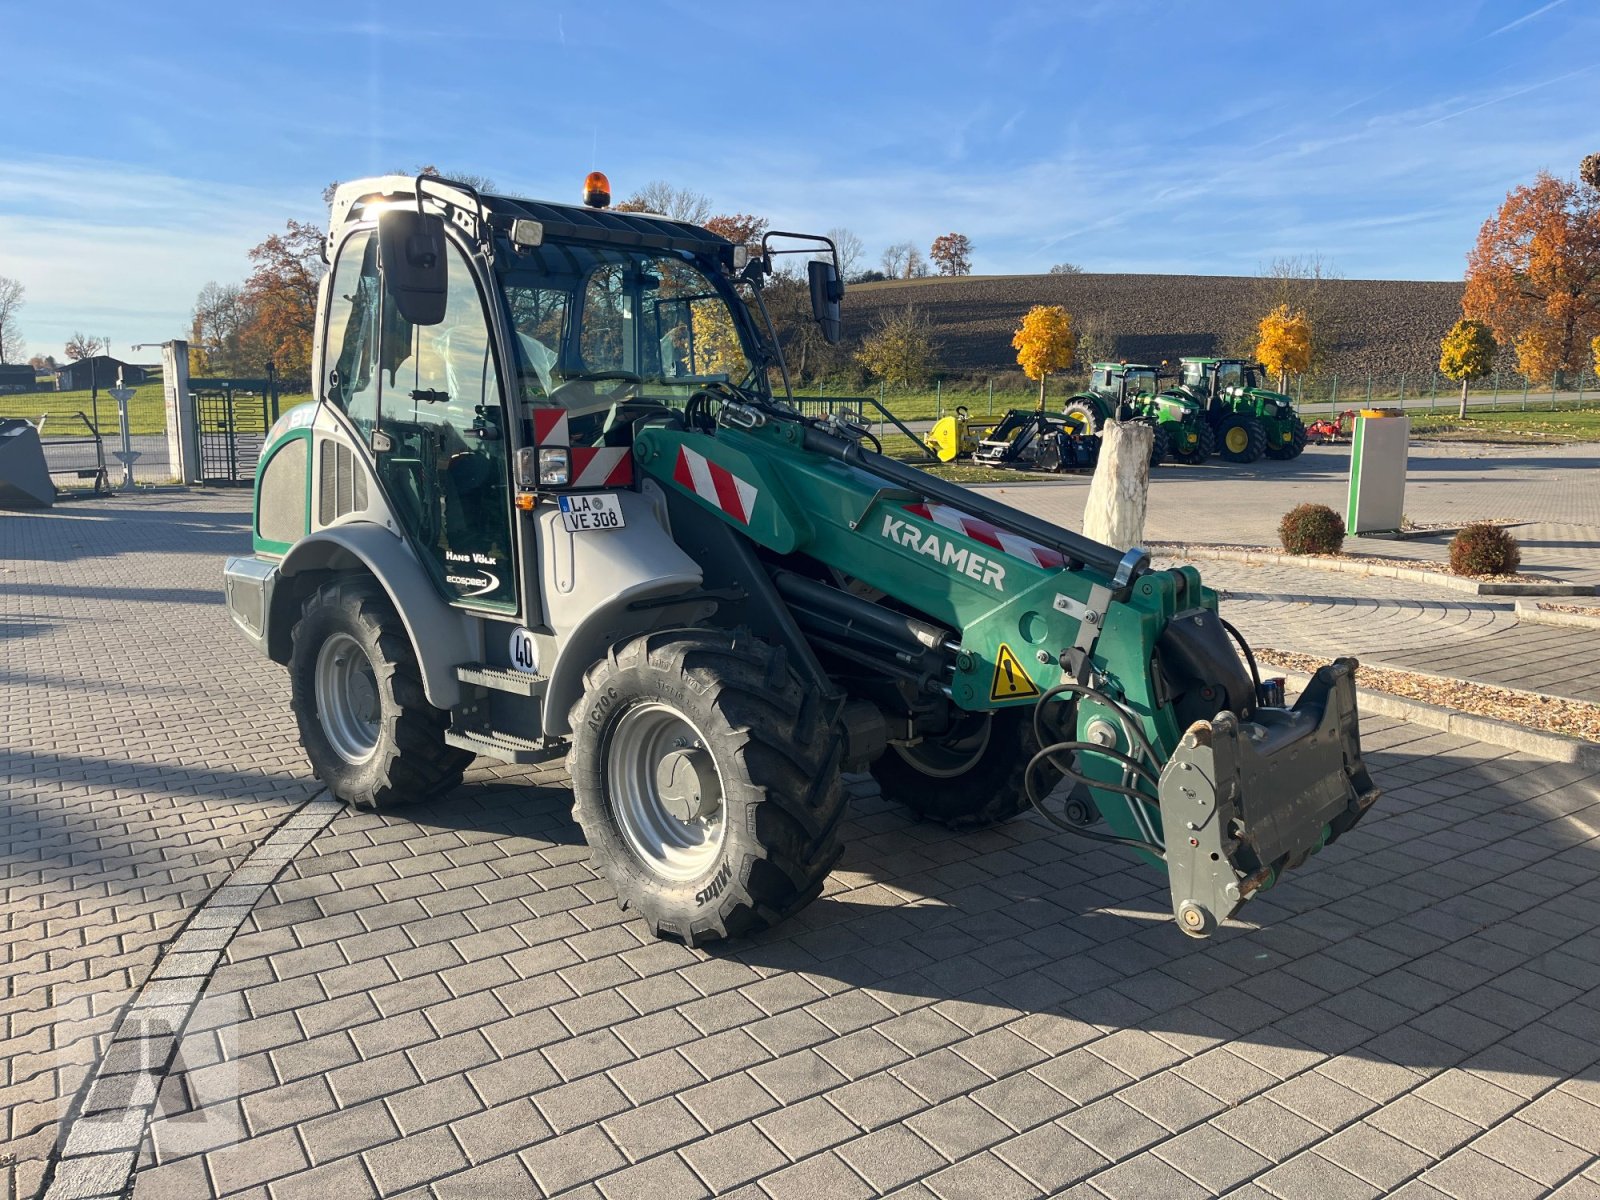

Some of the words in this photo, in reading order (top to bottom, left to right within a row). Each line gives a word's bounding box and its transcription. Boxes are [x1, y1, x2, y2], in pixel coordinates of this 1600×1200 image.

[570, 496, 591, 512] LA
[569, 513, 590, 529] VE
[592, 511, 618, 528] 308
[881, 514, 1006, 592] KRAMER
[446, 575, 487, 587] ecospeed
[515, 635, 533, 668] 40
[695, 854, 733, 908] Mitas
